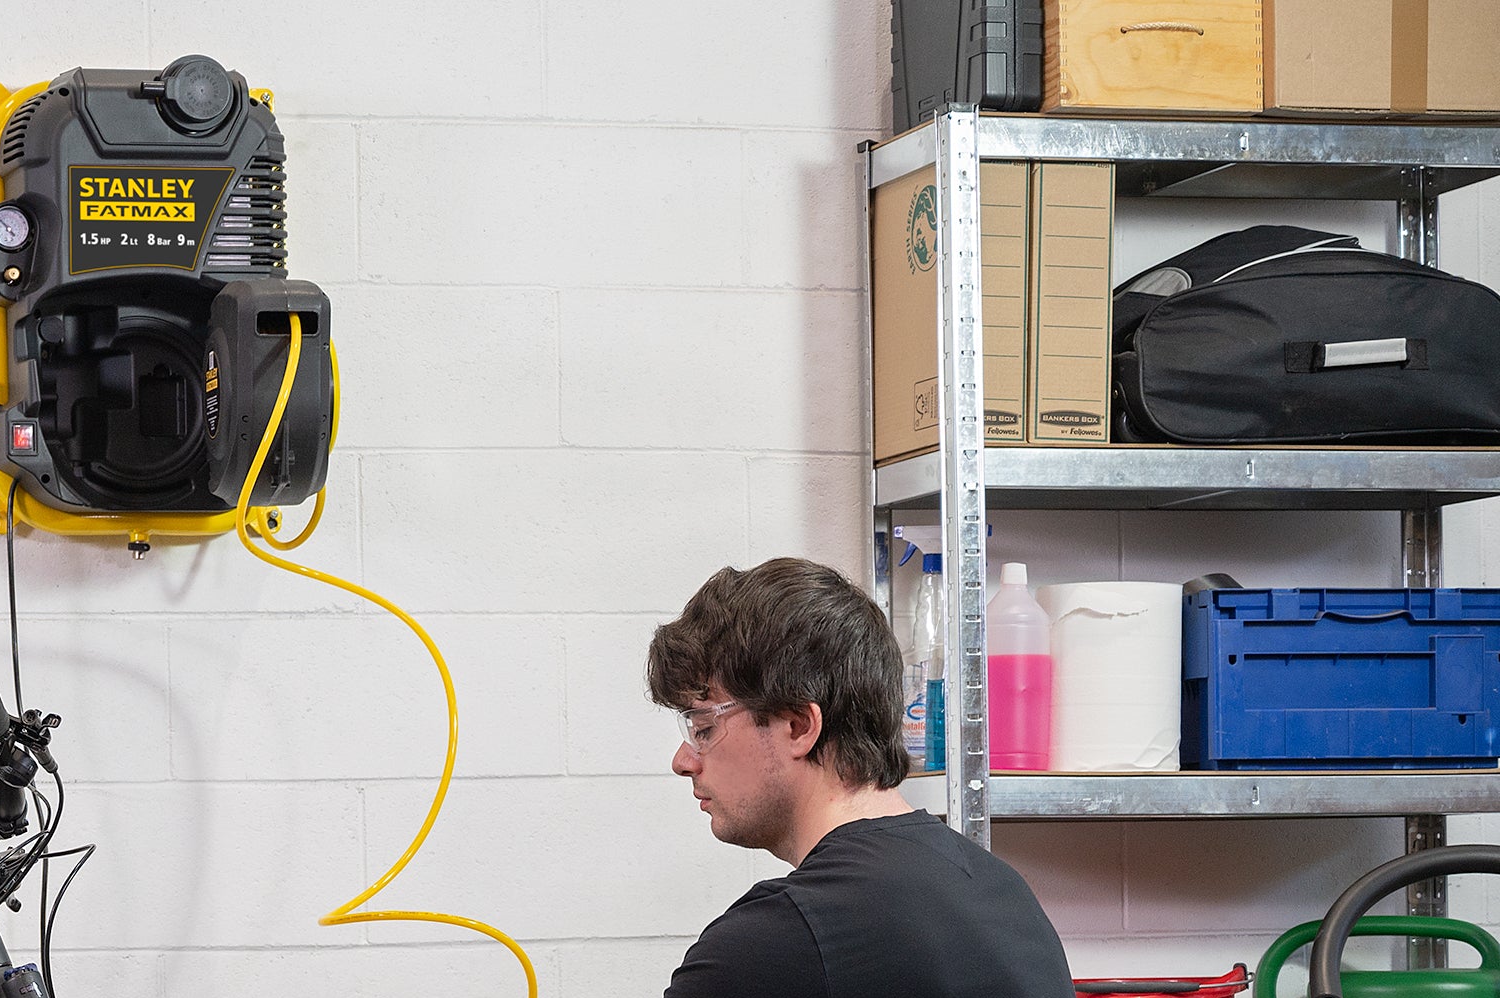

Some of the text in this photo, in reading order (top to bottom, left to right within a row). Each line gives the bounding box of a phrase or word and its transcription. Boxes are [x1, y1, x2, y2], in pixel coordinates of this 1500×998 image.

[79, 177, 195, 198] STANLEY
[86, 204, 190, 218] FATMAX
[80, 233, 99, 245] 1.5
[100, 237, 111, 245] HP
[120, 233, 128, 245] 2
[147, 233, 156, 245] 8
[157, 238, 171, 246] Bar
[177, 234, 185, 246] 9
[998, 415, 1016, 423] BOX
[1042, 415, 1099, 424] BANKERS BOX
[987, 427, 1016, 436] Fellowes
[1070, 428, 1100, 437] Fellowes
